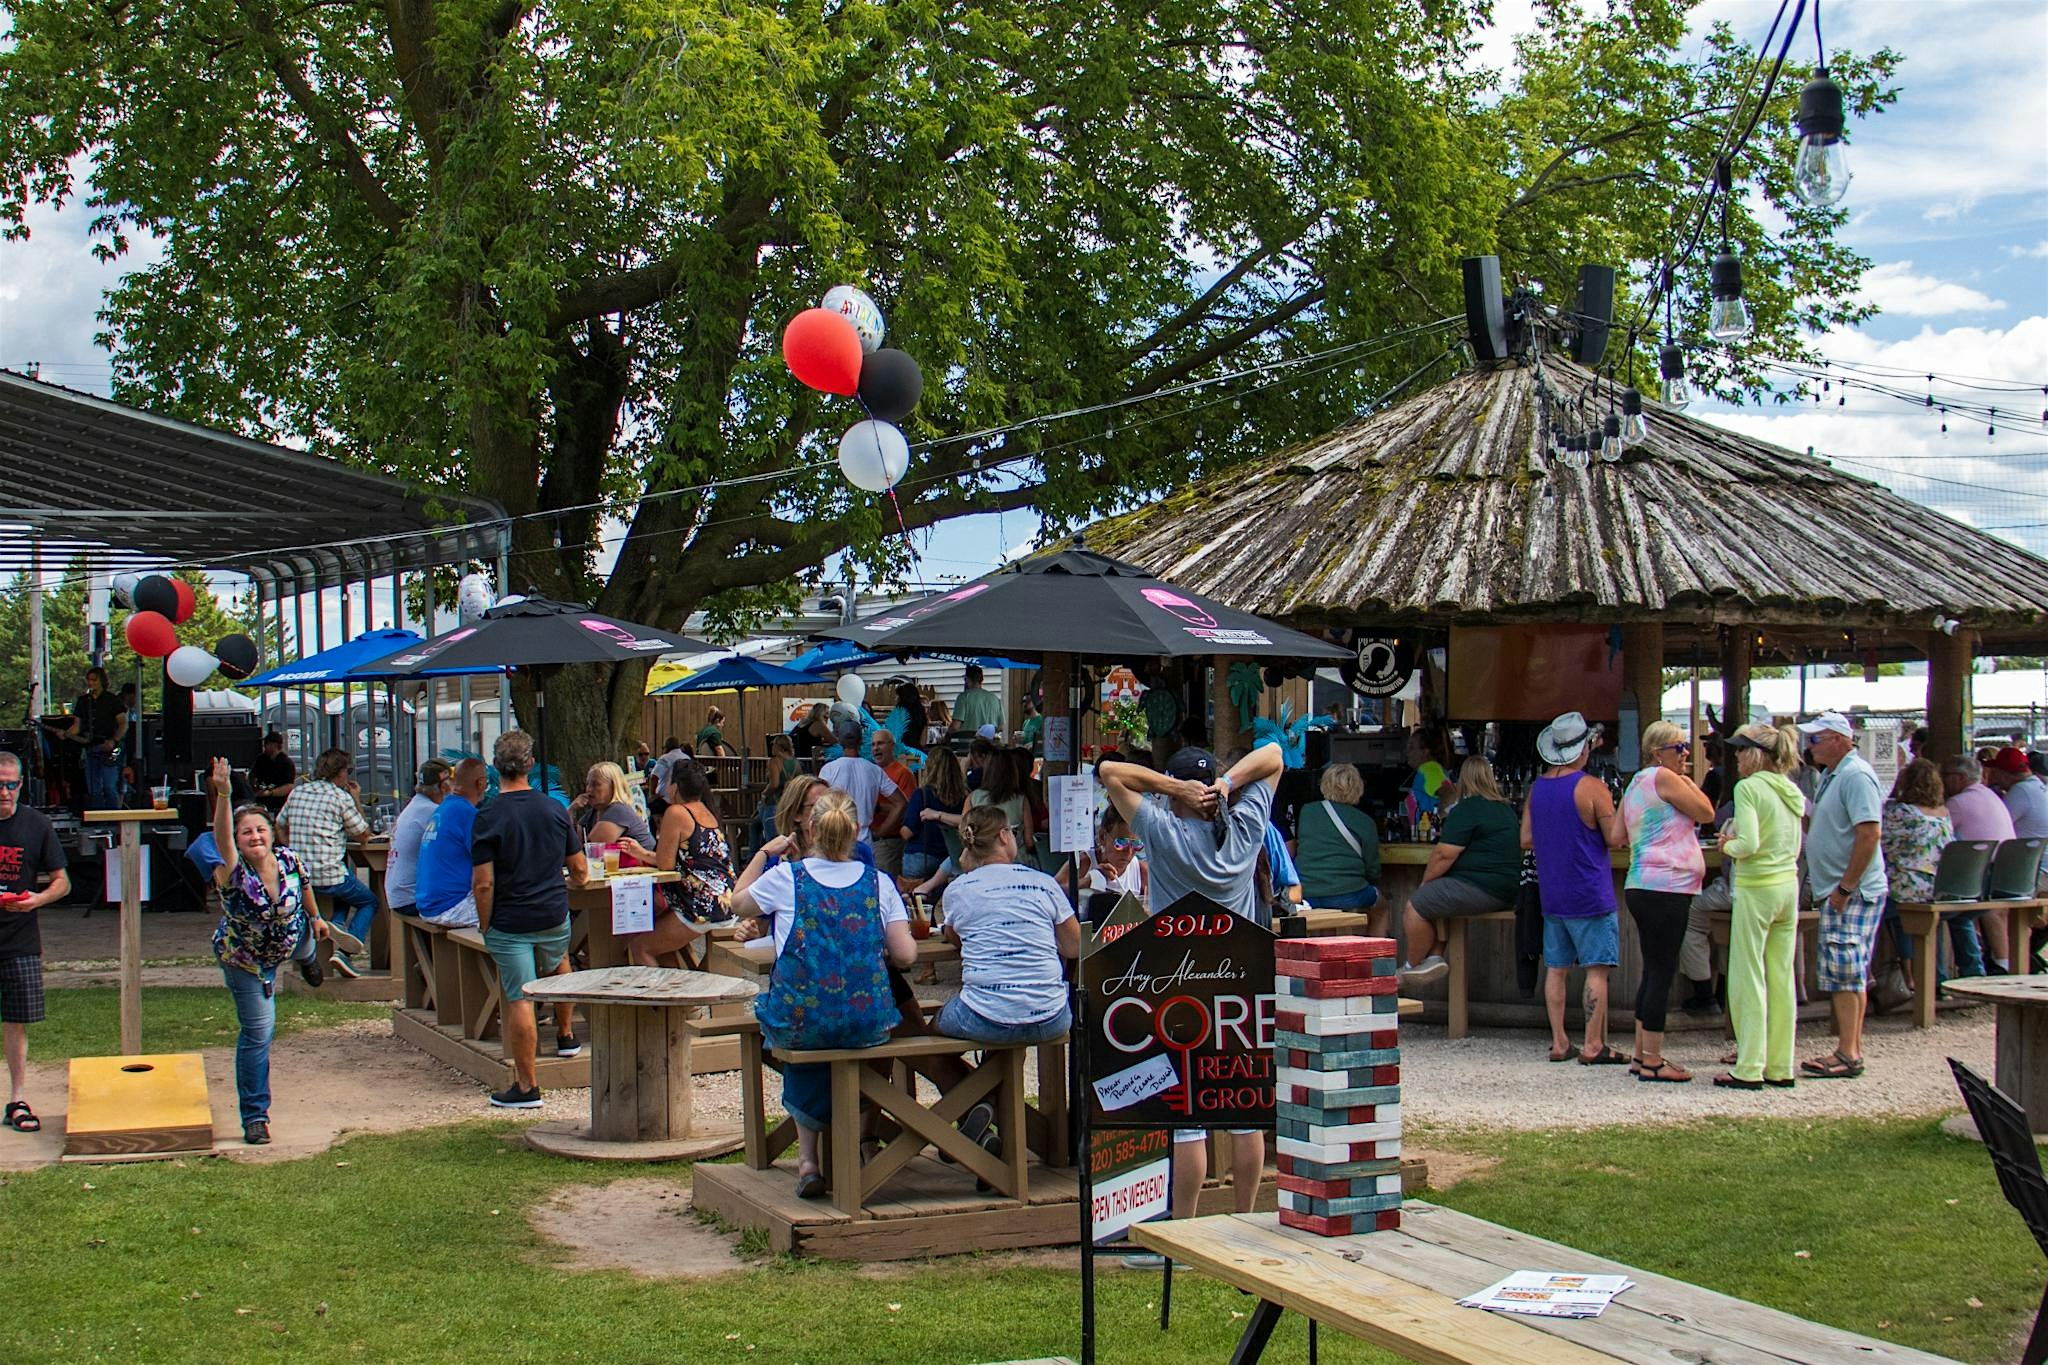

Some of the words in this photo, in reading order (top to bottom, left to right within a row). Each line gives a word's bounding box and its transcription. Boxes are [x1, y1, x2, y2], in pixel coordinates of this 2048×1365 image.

[0, 846, 24, 865] RE
[0, 864, 21, 873] ALTY
[1153, 914, 1234, 938] SOLD
[1102, 950, 1152, 995] Amy
[1151, 949, 1247, 994] Alexander's
[1102, 994, 1276, 1053] CORE
[1197, 1054, 1274, 1080] REALT
[1199, 1086, 1276, 1111] GROU
[1116, 1129, 1169, 1163] 585-4776
[1112, 1189, 1127, 1217] THIS
[1129, 1173, 1166, 1210] WEEKEND!
